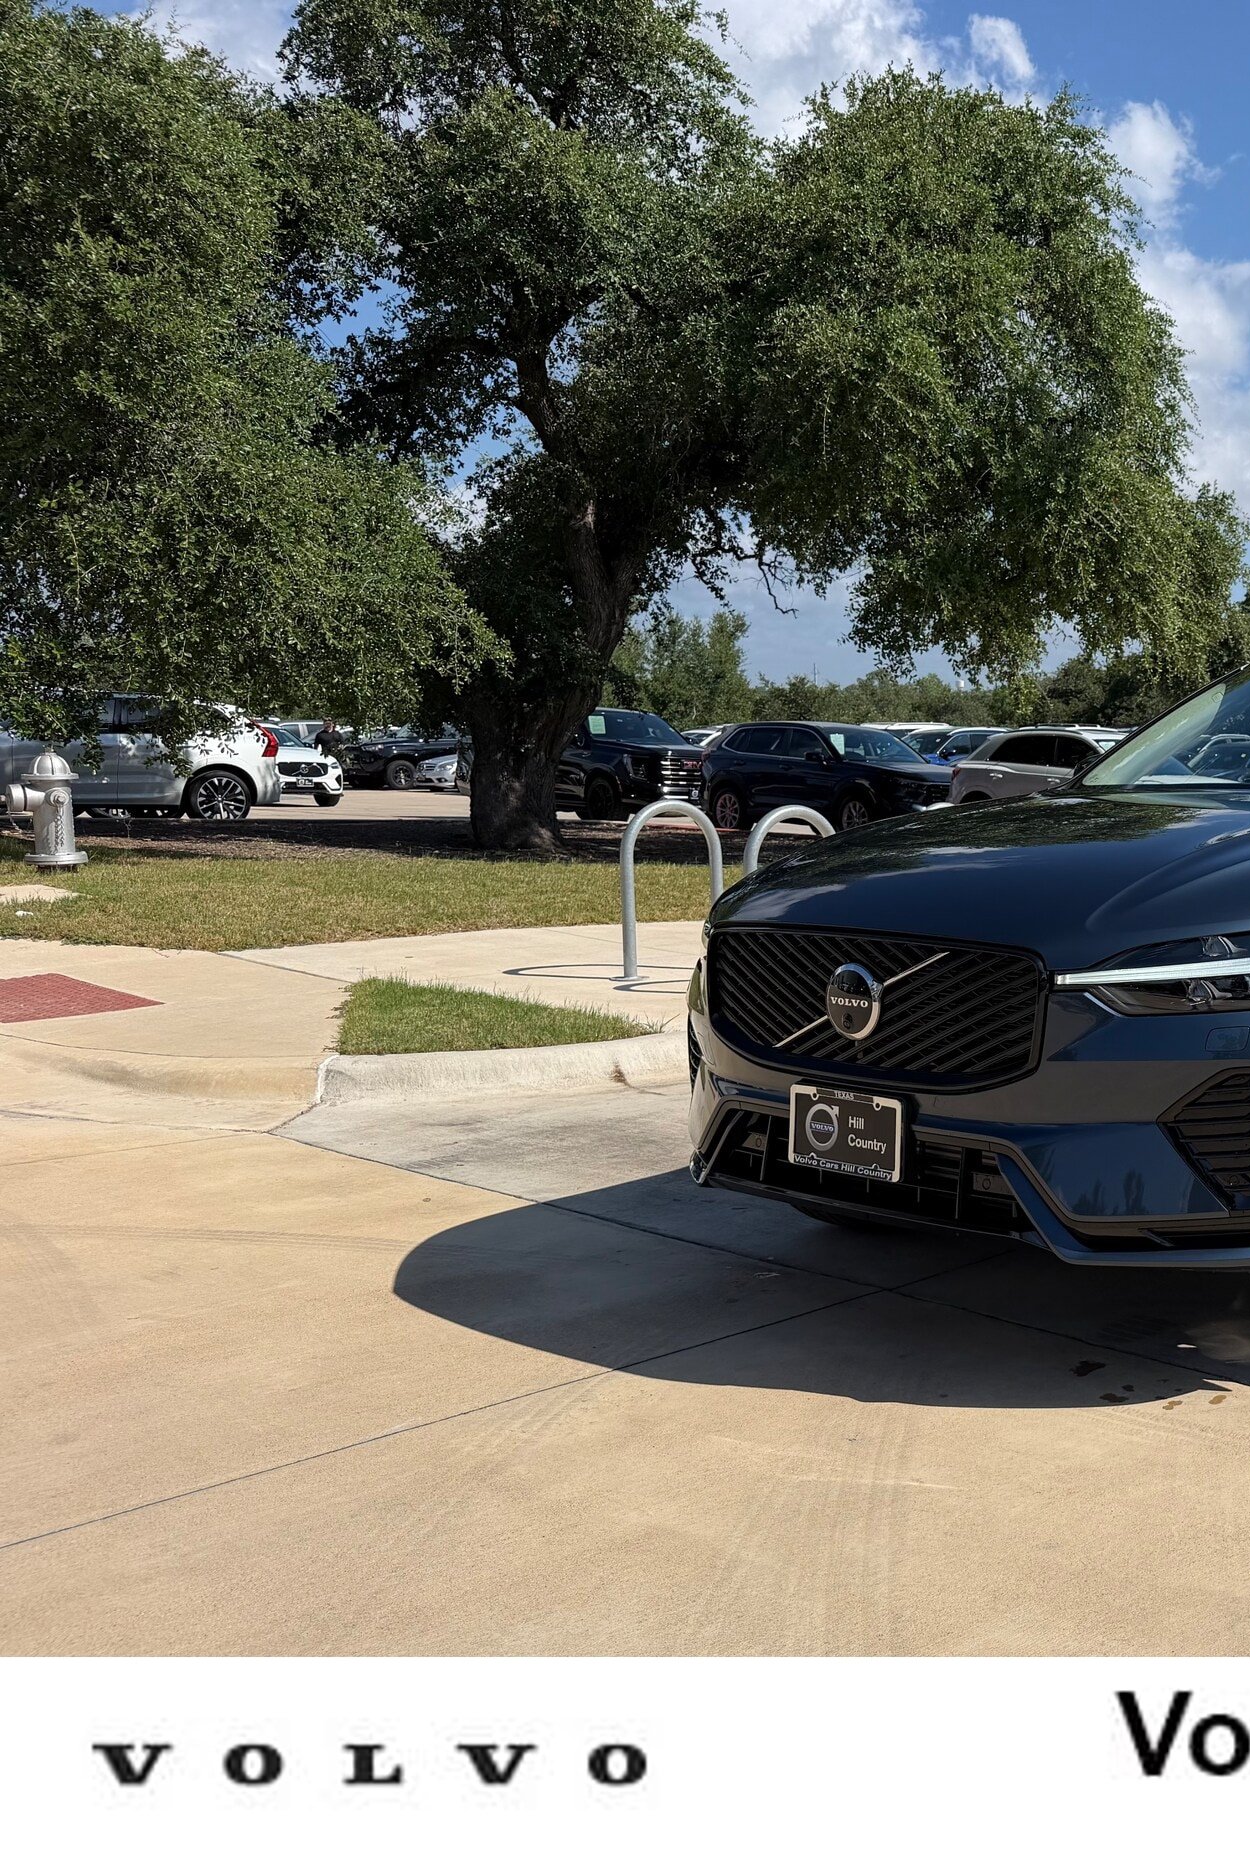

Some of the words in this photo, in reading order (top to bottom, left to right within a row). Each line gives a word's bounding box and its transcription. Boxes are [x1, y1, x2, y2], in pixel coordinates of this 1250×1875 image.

[830, 996, 868, 1008] VOLVO
[834, 1090, 854, 1100] TEXAS
[811, 1122, 834, 1132] VOLVO
[848, 1115, 864, 1130] Hill
[847, 1134, 887, 1154] Country
[795, 1155, 818, 1166] Volvo
[820, 1159, 839, 1170] Cars
[841, 1163, 855, 1173] Hill
[857, 1166, 892, 1181] Country
